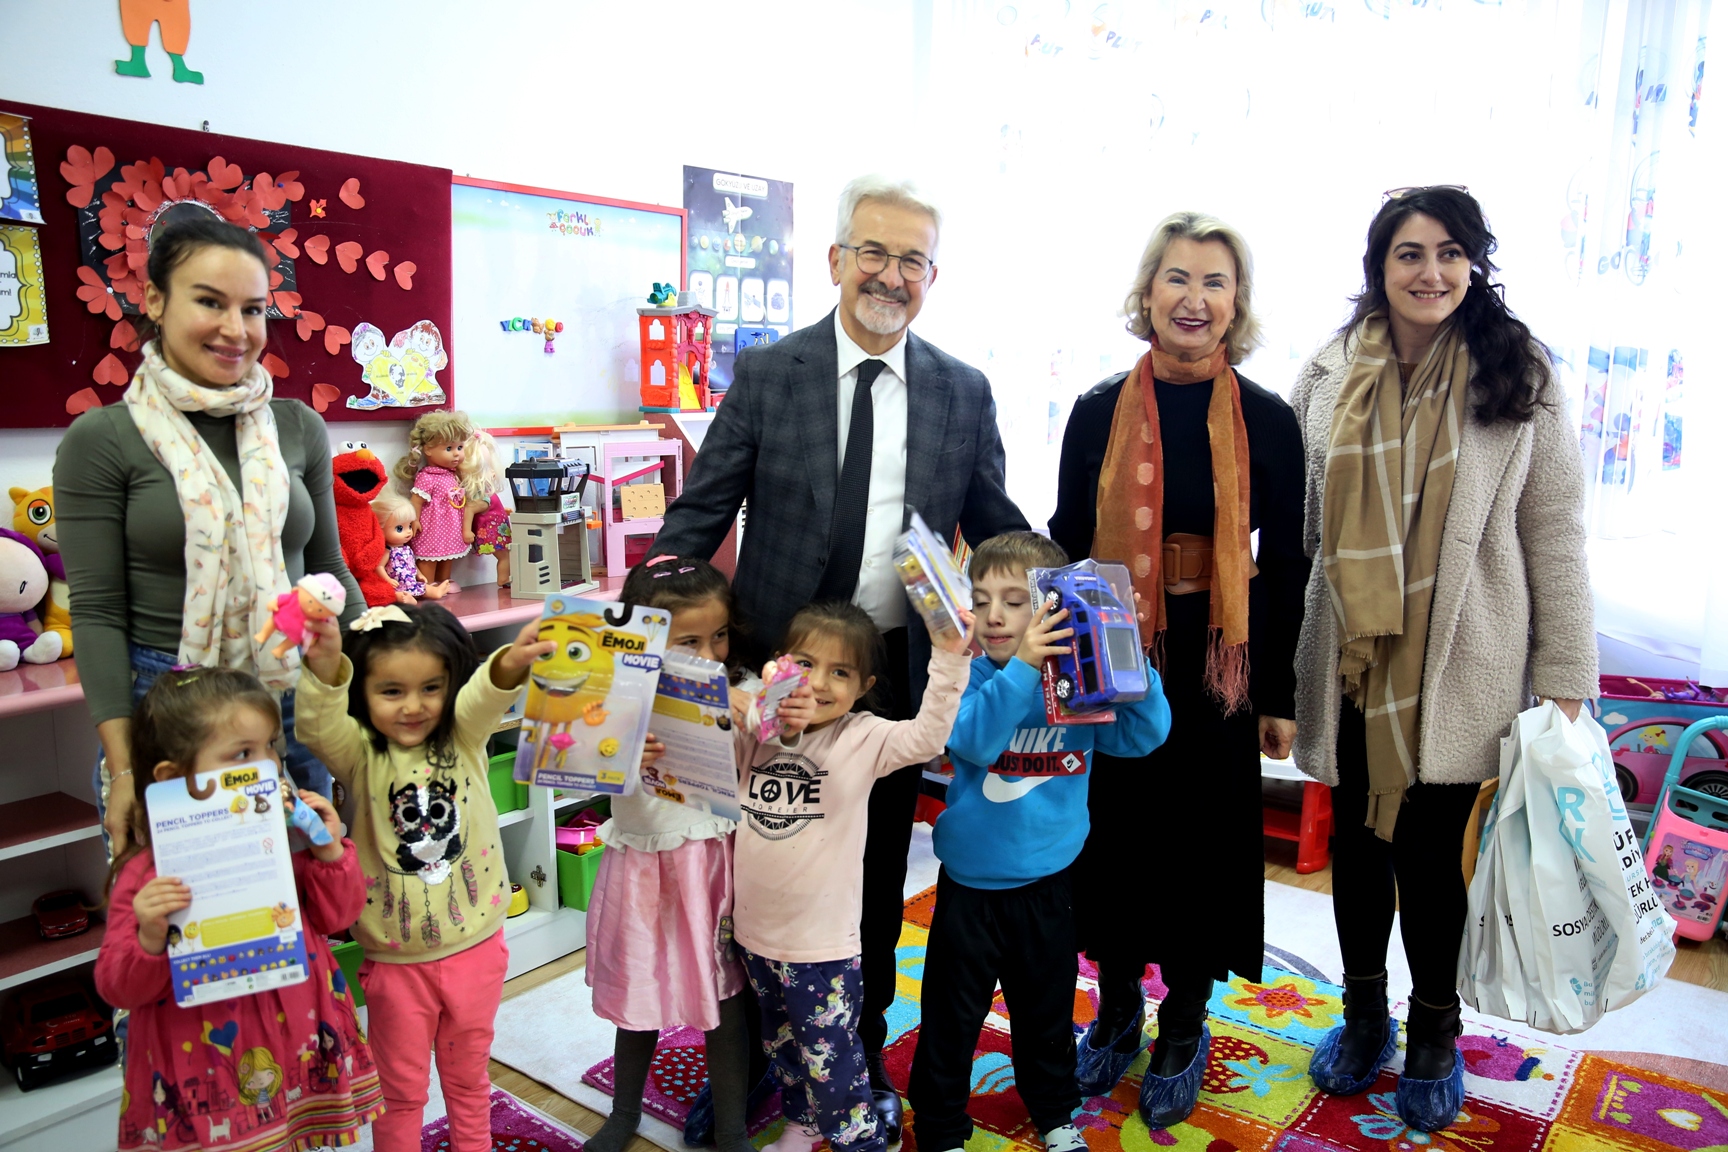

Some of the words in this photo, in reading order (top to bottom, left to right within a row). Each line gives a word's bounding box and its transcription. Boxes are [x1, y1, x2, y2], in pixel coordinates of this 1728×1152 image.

[602, 635, 645, 651] EMOJI
[623, 654, 660, 668] MOVIE
[1022, 757, 1045, 773] DO
[1046, 756, 1061, 772] IT.
[224, 772, 259, 787] EMOJI
[538, 773, 562, 781] PENCIL
[564, 776, 595, 785] TOPPERS
[245, 780, 275, 795] MOVIE
[655, 787, 682, 801] EMOJI
[749, 774, 821, 805] LOVE
[156, 816, 187, 828] PENCIL
[190, 808, 229, 822] TOPPERS
